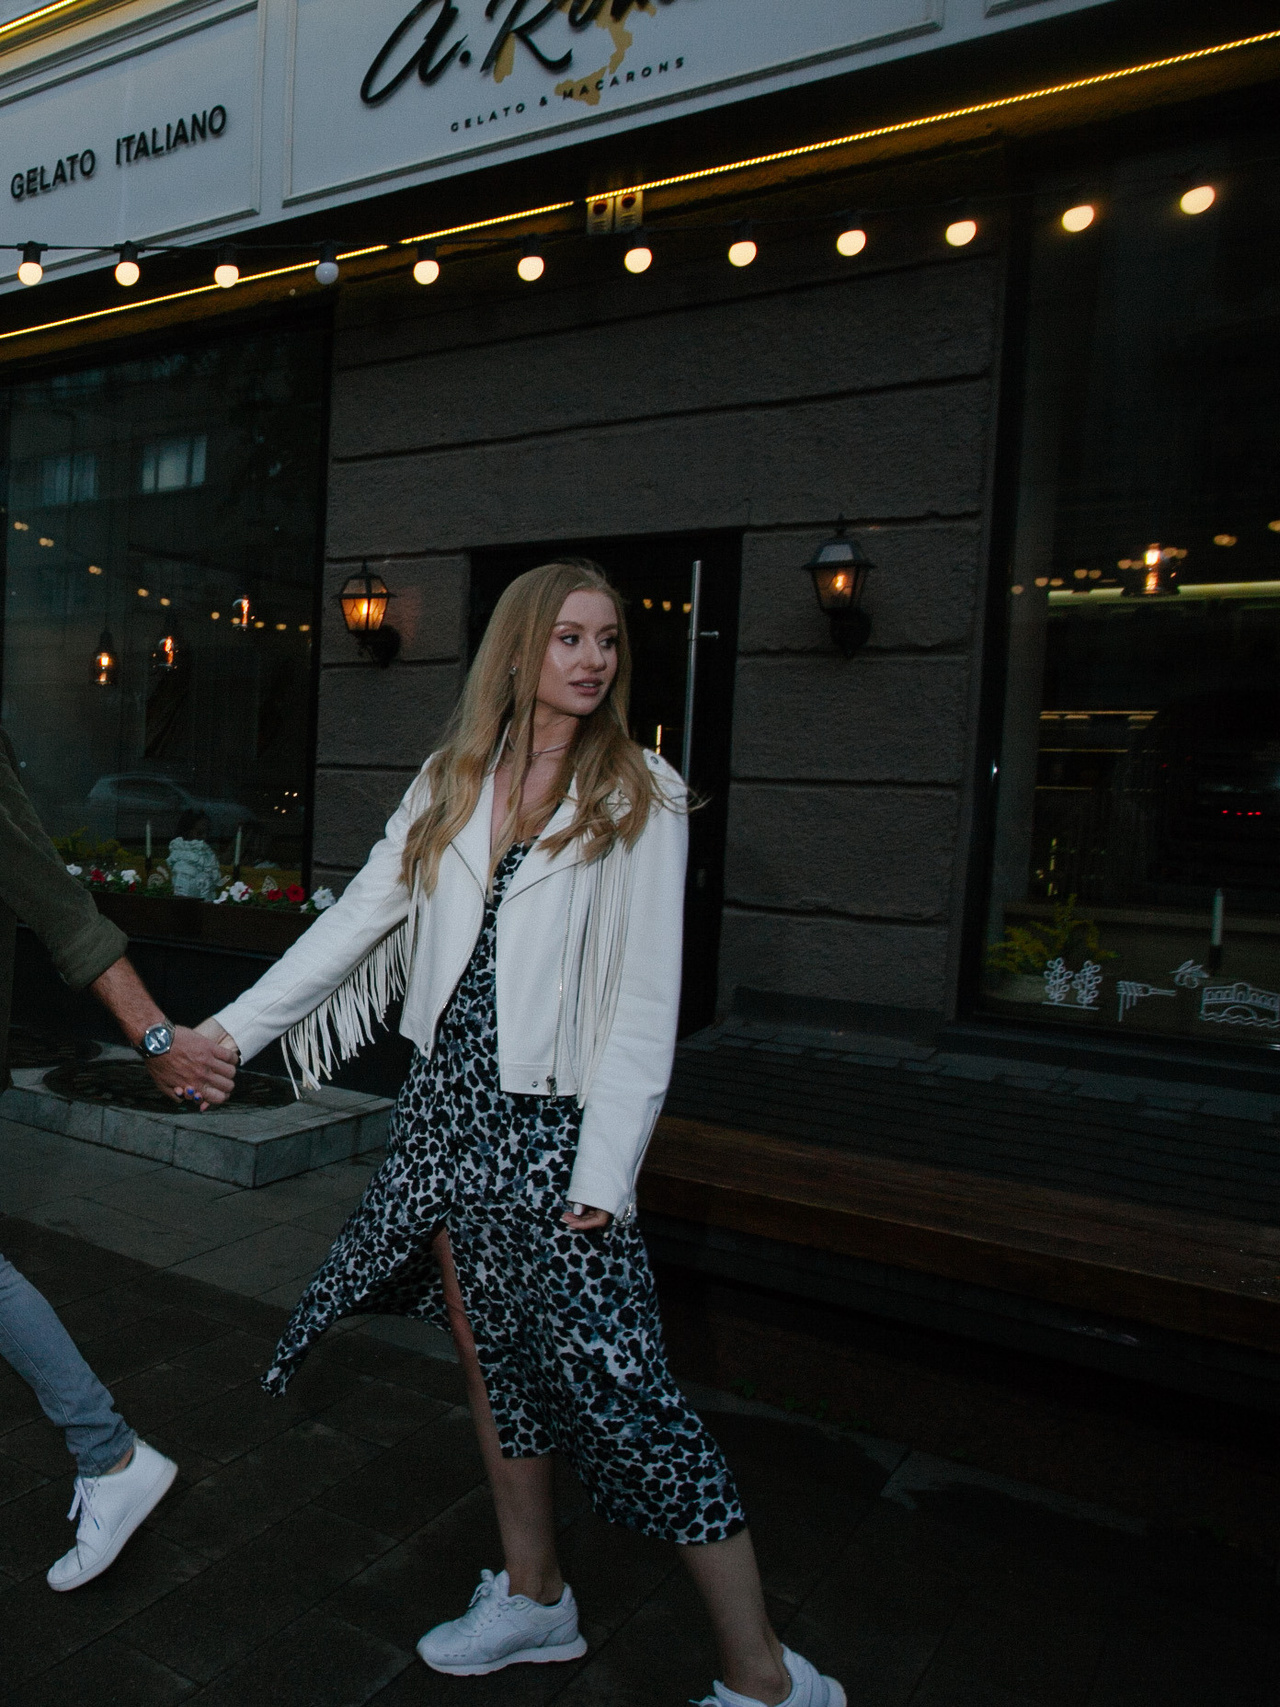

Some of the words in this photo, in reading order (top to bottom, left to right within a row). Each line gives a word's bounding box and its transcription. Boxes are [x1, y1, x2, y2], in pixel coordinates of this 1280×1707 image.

[451, 103, 525, 132] GELATO
[539, 96, 548, 106] &
[563, 57, 684, 99] MACARONS
[11, 149, 95, 199] GELATO
[116, 105, 226, 166] ITALIANO
